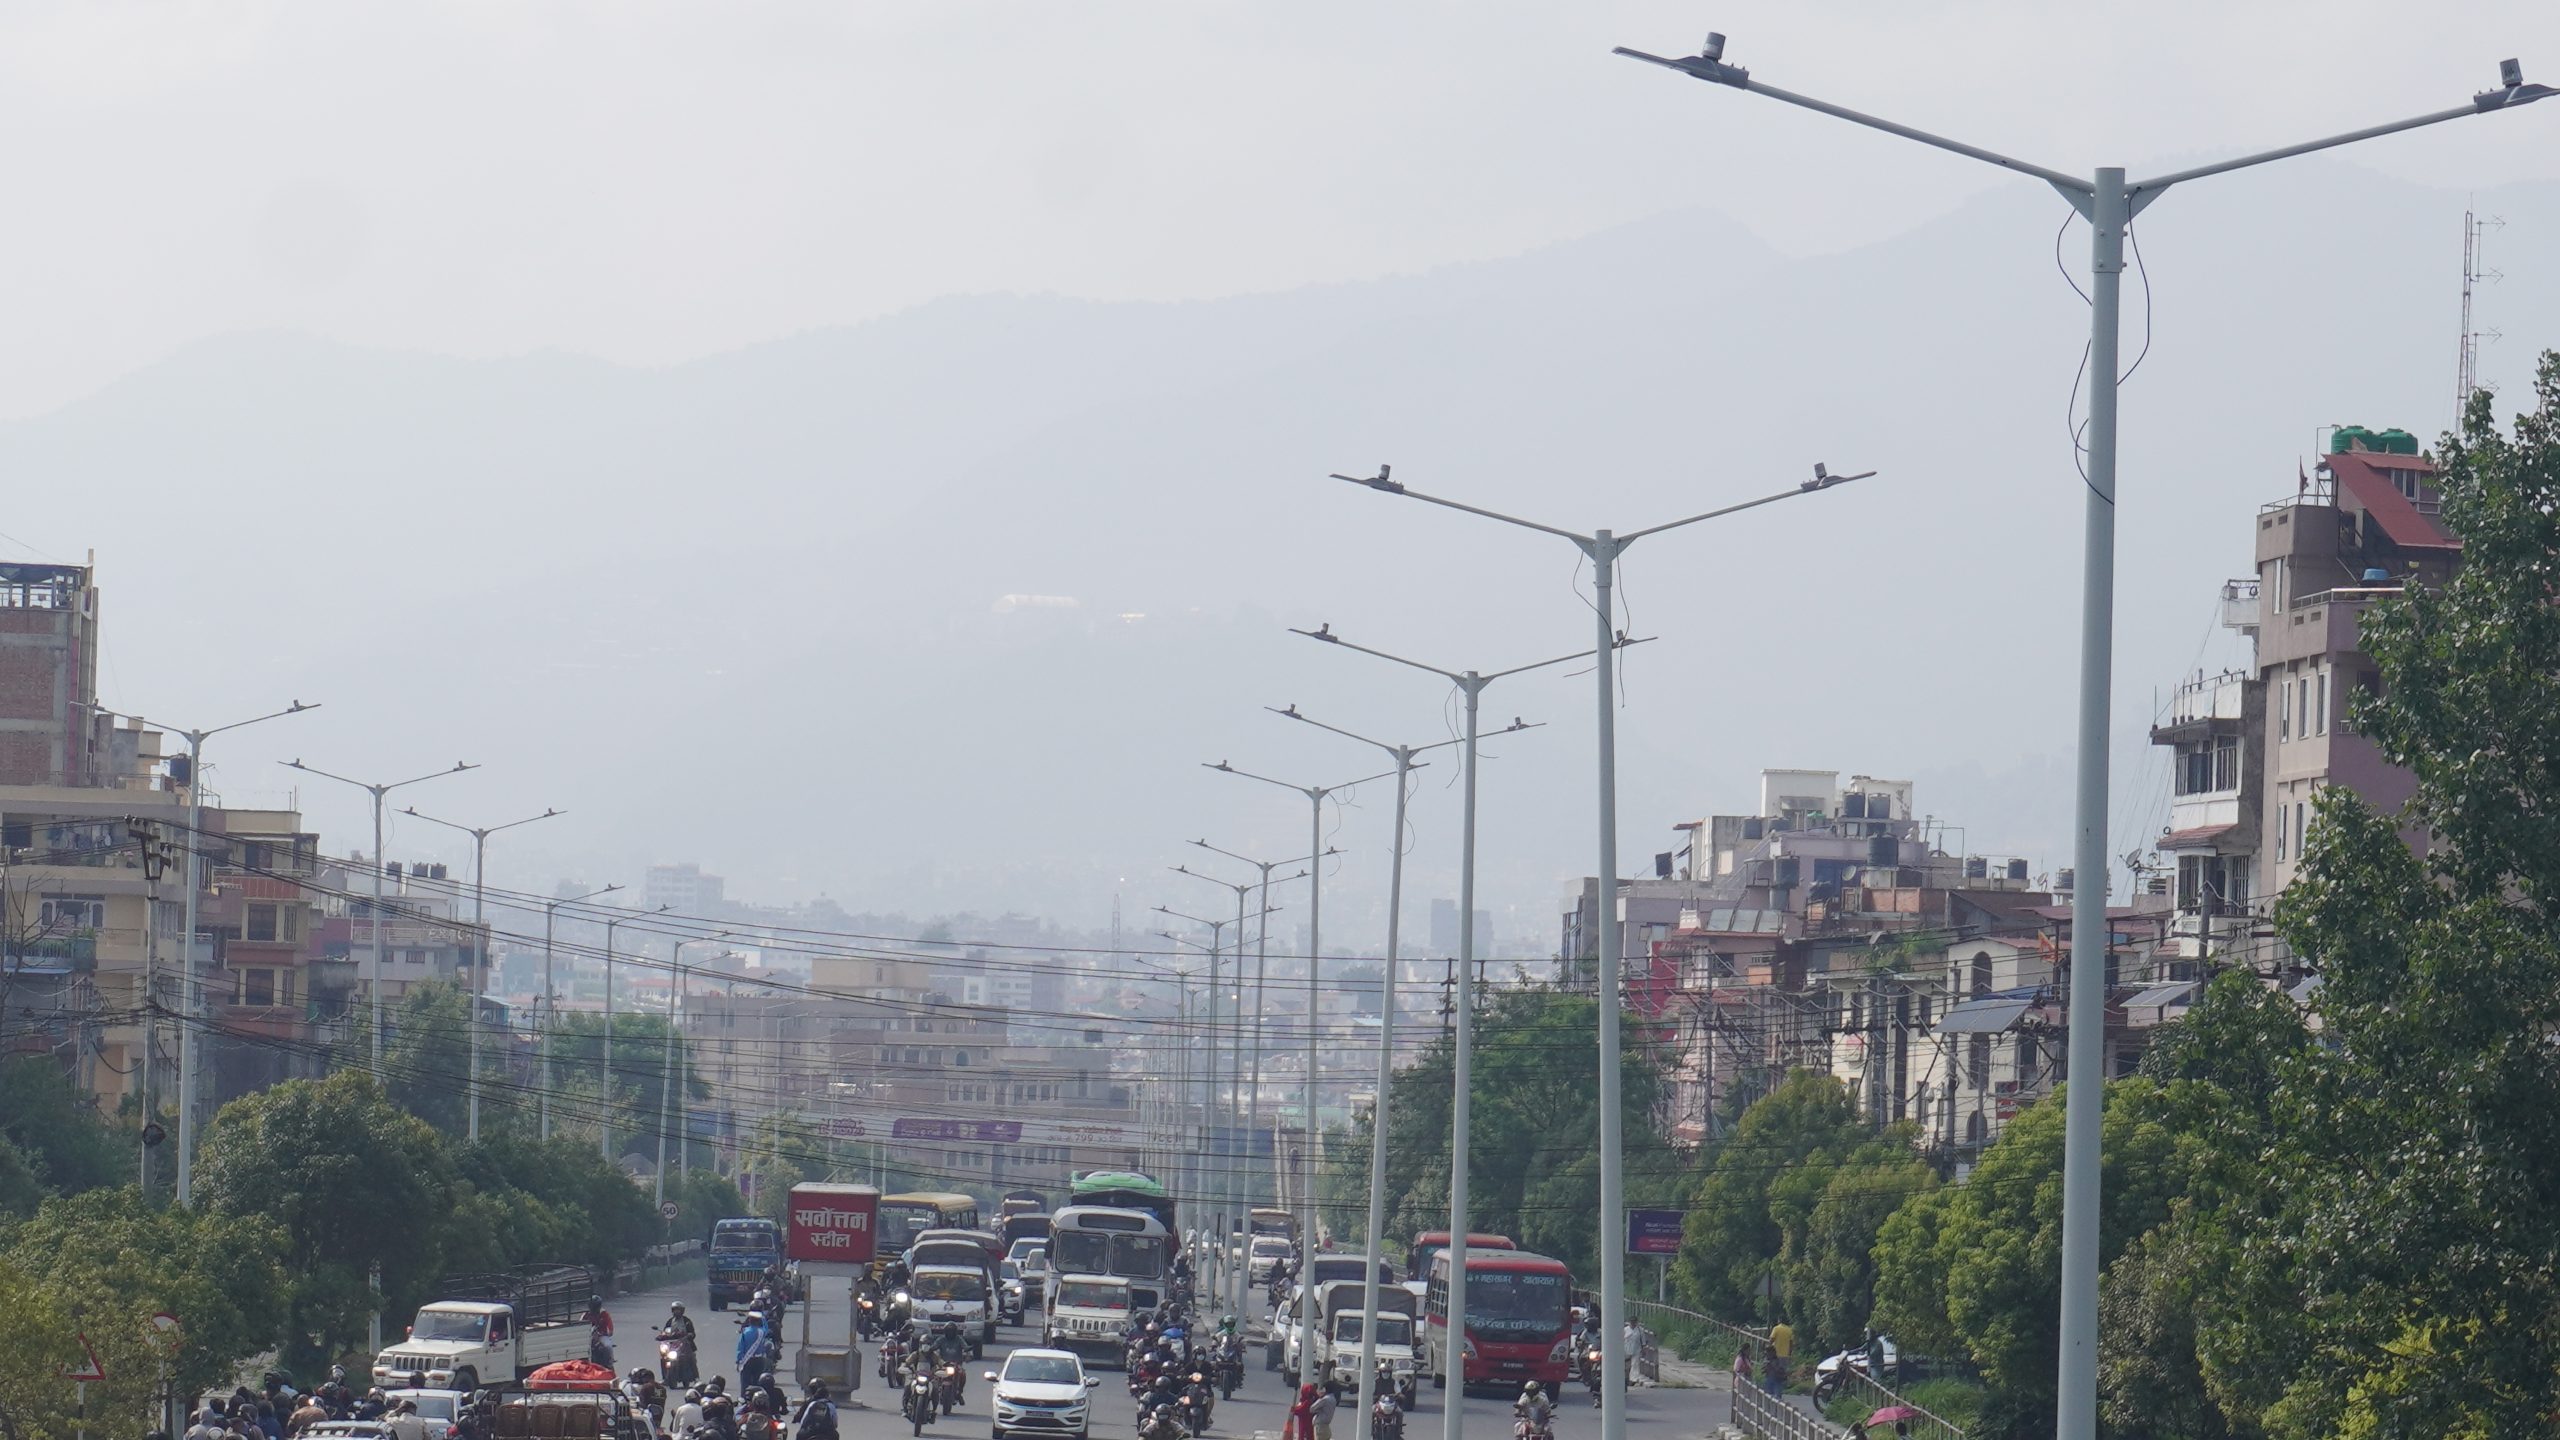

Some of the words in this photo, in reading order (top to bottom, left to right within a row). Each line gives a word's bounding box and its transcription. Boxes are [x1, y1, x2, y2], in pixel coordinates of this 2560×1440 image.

[663, 1206, 676, 1215] 50
[880, 1206, 910, 1214] SCHOOL
[795, 1207, 869, 1232] सर्वोत्तम
[811, 1231, 851, 1248] स्टील
